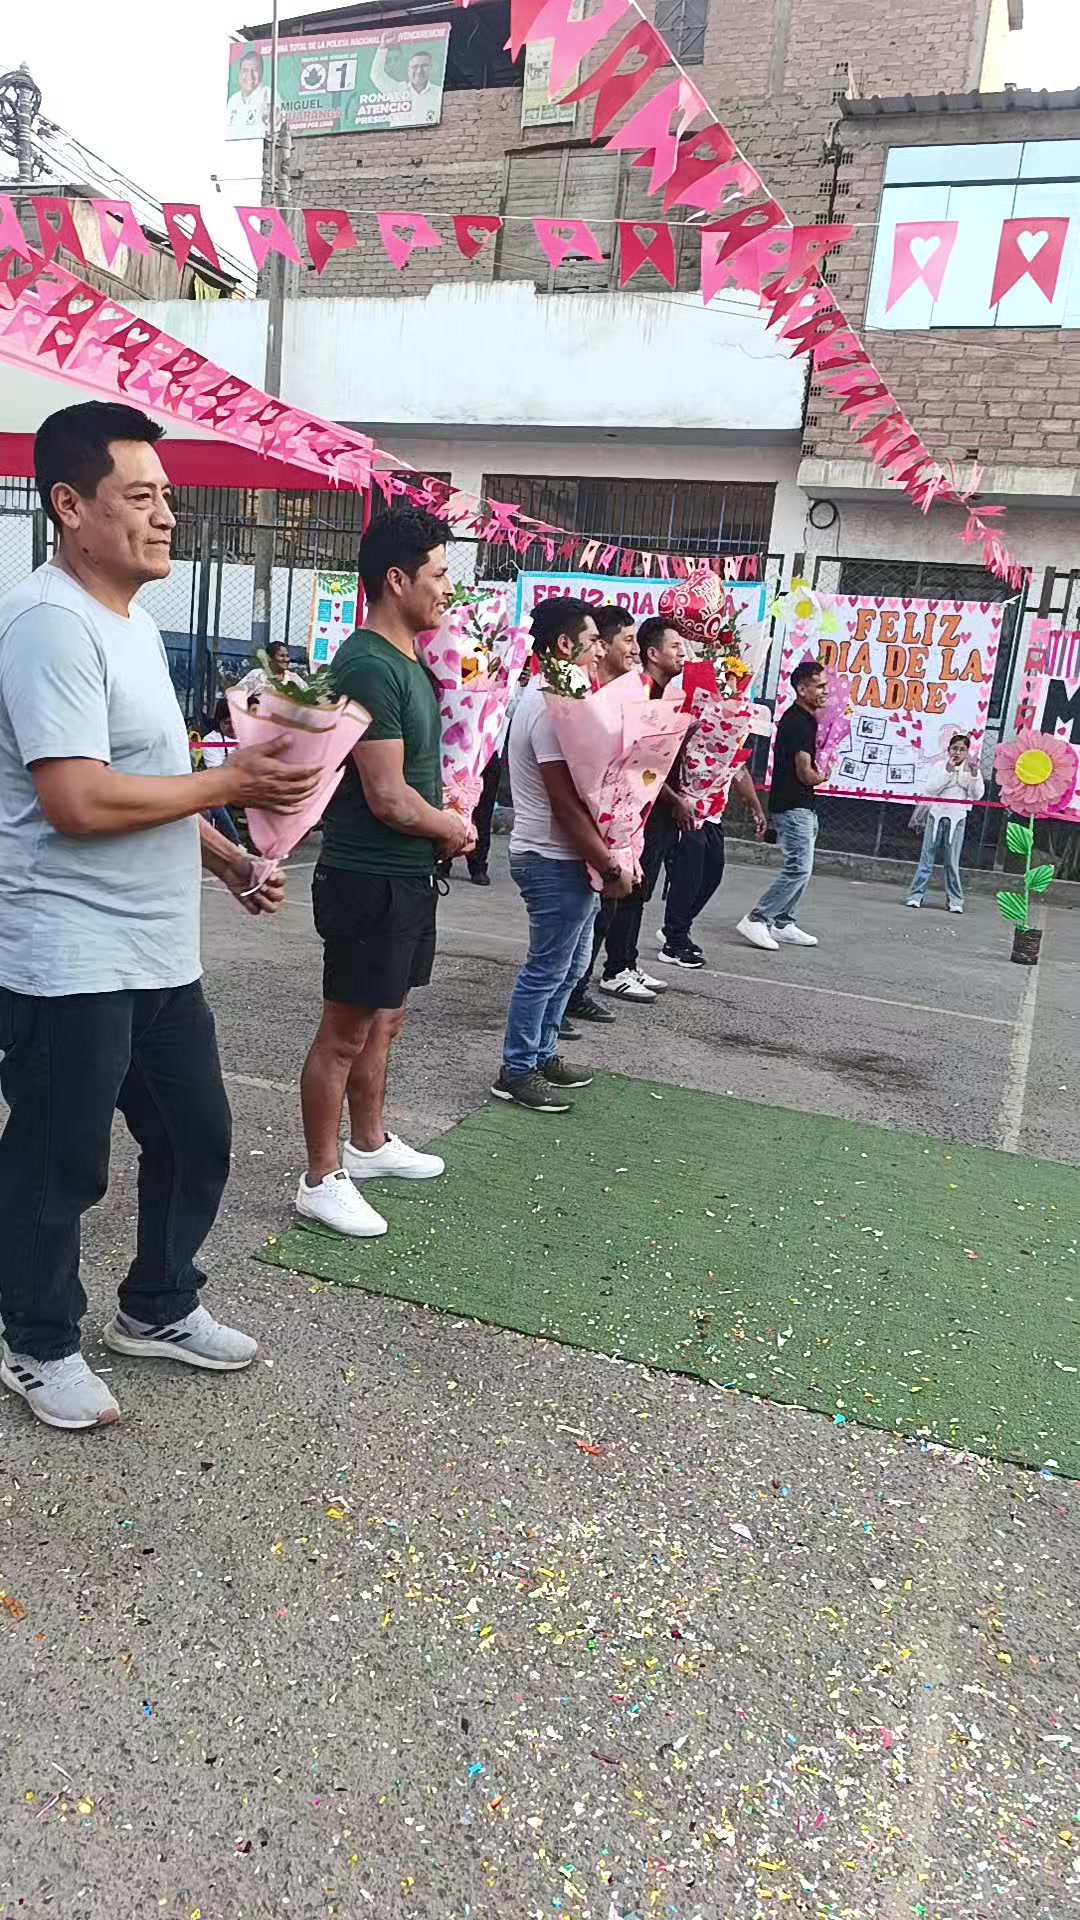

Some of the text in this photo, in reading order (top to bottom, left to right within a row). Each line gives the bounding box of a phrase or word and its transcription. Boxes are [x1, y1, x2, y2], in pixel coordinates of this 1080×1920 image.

[317, 40, 326, 50] LA
[335, 63, 348, 89] 1
[280, 99, 323, 111] MIGUEL
[359, 90, 411, 104] RONALD
[357, 101, 411, 116] ATENCIO
[616, 591, 654, 614] DIA
[853, 608, 962, 647] FELIZ
[818, 639, 984, 682] DIA DE LA
